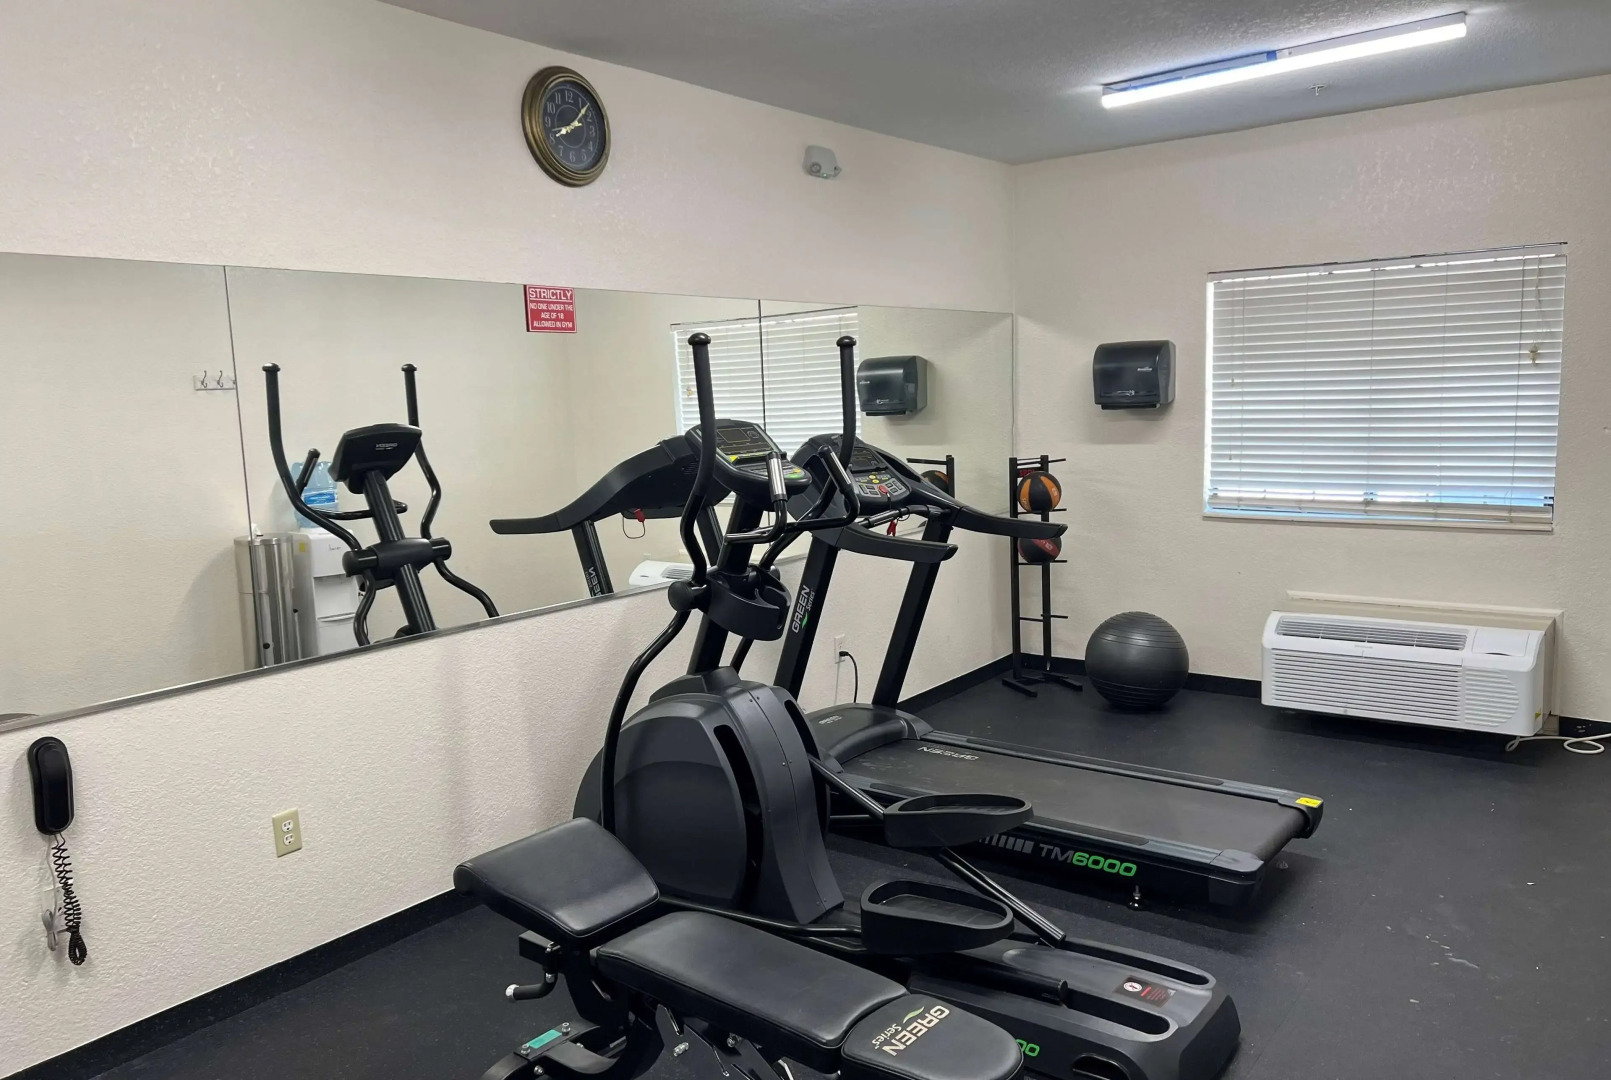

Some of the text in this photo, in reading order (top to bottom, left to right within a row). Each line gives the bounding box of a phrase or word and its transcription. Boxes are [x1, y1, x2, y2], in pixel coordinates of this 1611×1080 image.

[555, 92, 561, 104] 11
[565, 90, 574, 103] 12
[546, 102, 556, 114] 10
[545, 116, 551, 128] 9
[586, 112, 592, 122] 2
[590, 126, 596, 137] 3
[550, 134, 556, 144] 8
[558, 146, 564, 156] 7
[588, 142, 593, 152] 4
[570, 150, 576, 162] 6
[582, 149, 587, 160] 5
[530, 288, 572, 300] STRICTLY
[806, 591, 815, 611] Series
[792, 585, 810, 633] GREEN
[918, 746, 979, 760] GREEN
[1039, 844, 1137, 877] TM6000
[872, 1024, 902, 1050] Series
[882, 1006, 950, 1056] GREEN
